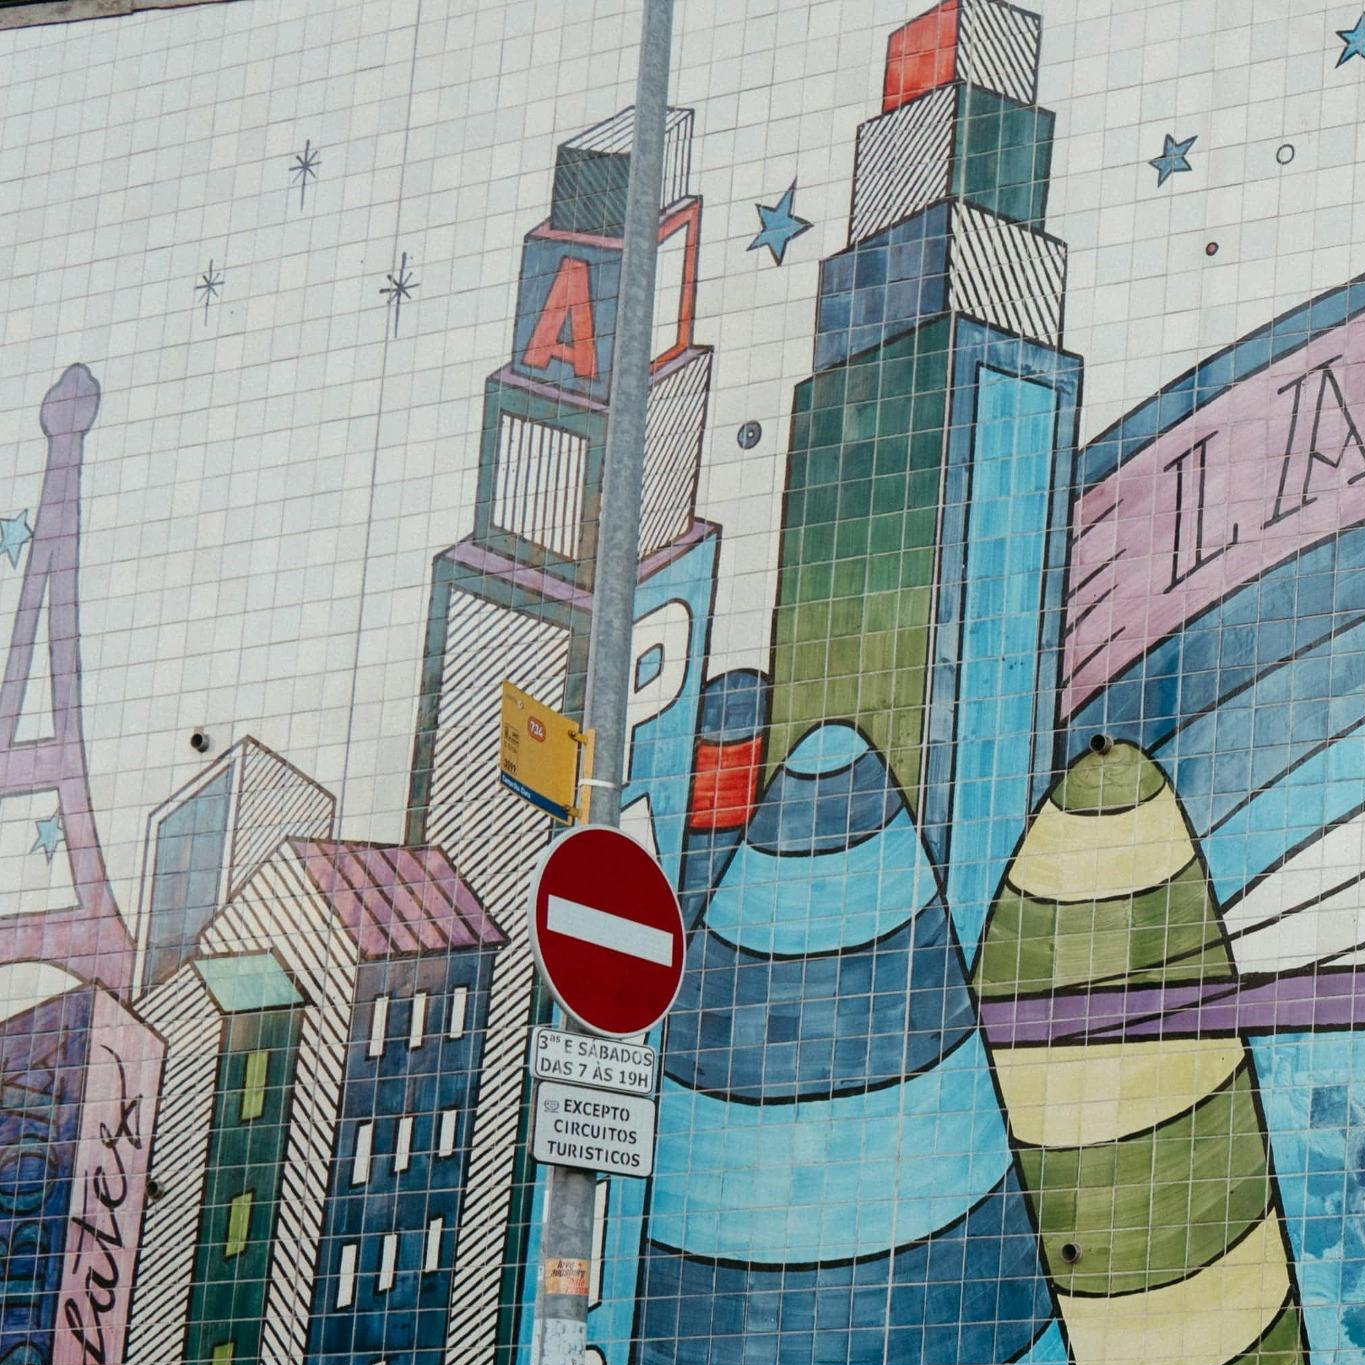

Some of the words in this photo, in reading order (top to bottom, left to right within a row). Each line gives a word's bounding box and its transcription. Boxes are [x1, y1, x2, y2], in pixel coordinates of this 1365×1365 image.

[564, 1039, 574, 1054] E
[540, 1056, 574, 1077] DAS
[578, 1062, 588, 1078] 7
[618, 1069, 649, 1088] 19H
[563, 1098, 631, 1122] EXCEPTO
[553, 1118, 638, 1145] CIRCUITOS
[547, 1140, 641, 1168] TURISTICOS
